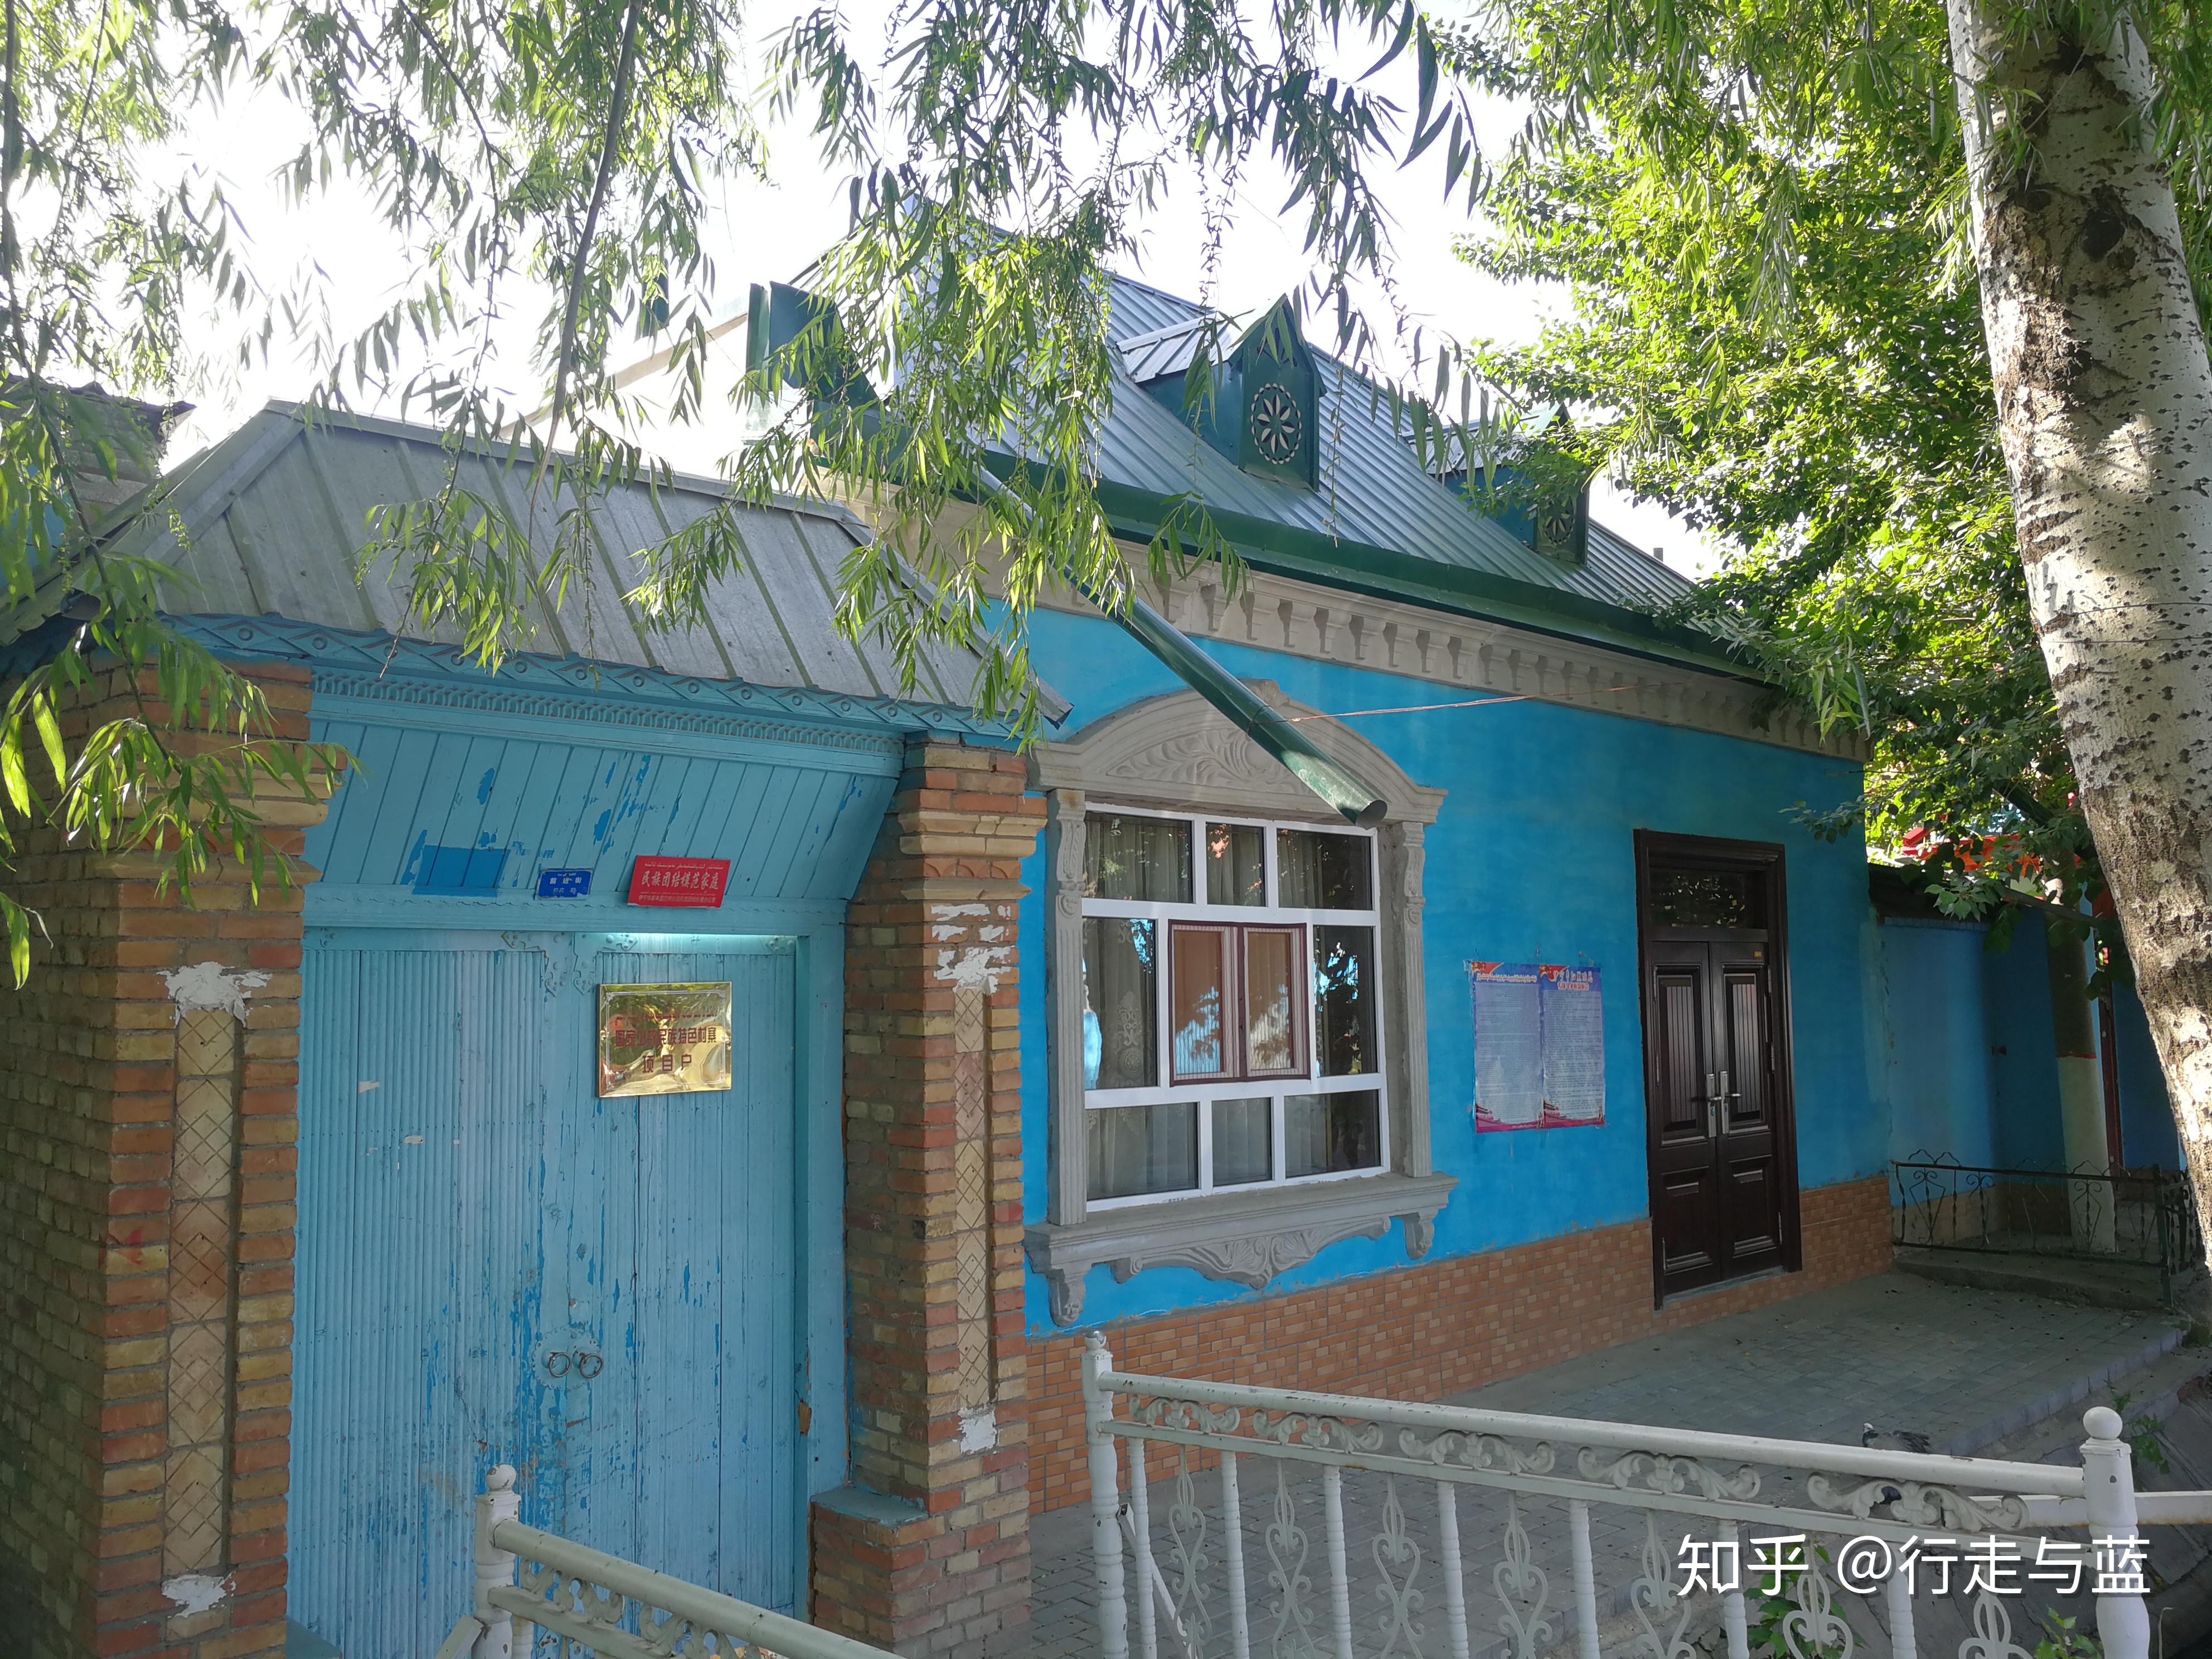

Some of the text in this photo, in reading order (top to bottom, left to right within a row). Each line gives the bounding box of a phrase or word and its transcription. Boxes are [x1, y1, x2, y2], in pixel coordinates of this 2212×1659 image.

[642, 870, 719, 890] 民族团结模范家庭
[615, 1027, 717, 1047] 国家少数民族特色村寨
[642, 1054, 692, 1073] 项目户
